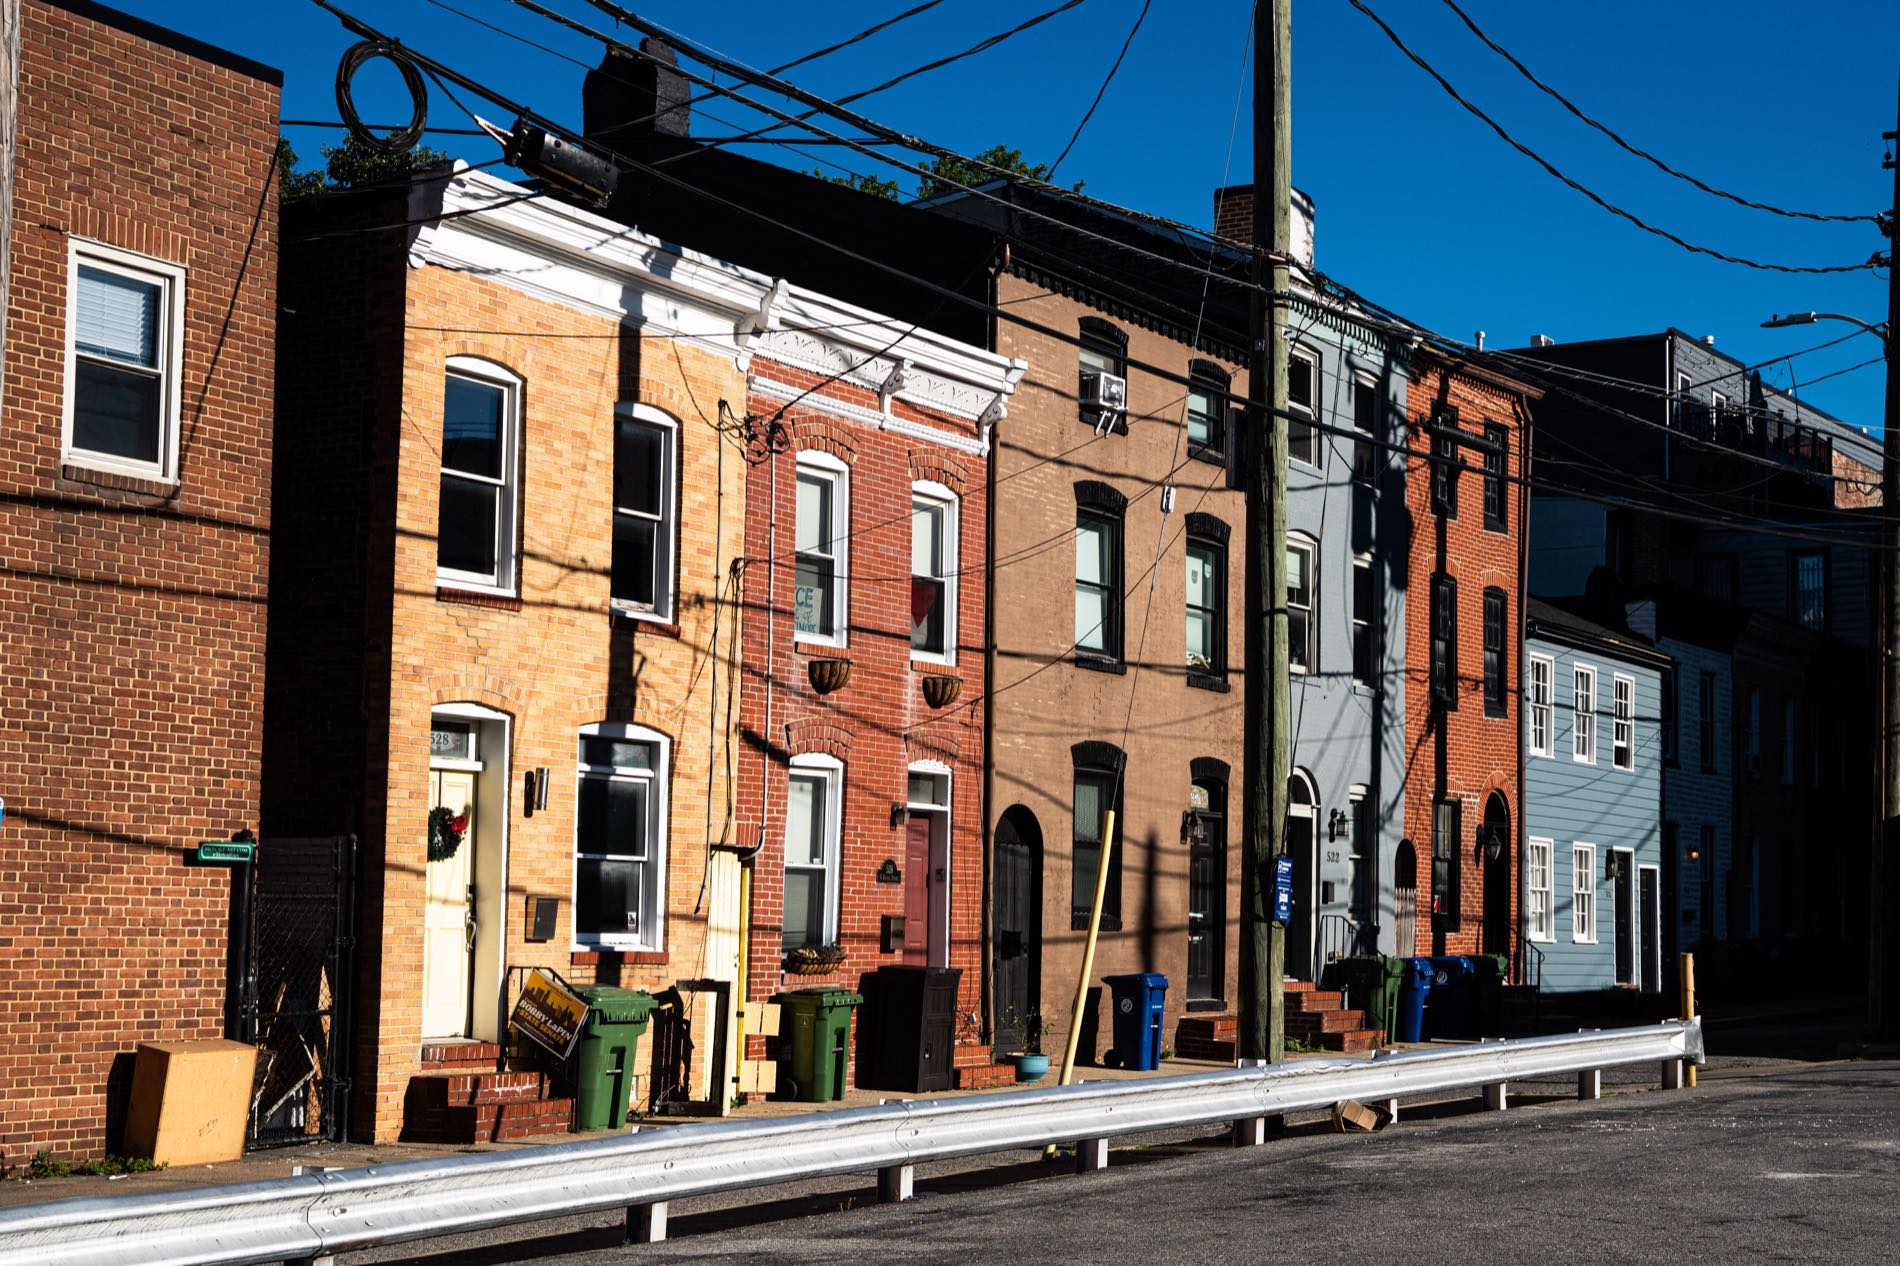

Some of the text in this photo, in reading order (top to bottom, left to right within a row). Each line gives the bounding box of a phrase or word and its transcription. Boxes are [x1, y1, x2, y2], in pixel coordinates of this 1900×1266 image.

[431, 733, 449, 745] 528
[1327, 850, 1340, 864] 522
[519, 1000, 549, 1022] BOBBY
[546, 1019, 573, 1040] LaPIN
[519, 1010, 541, 1026] STATE
[540, 1024, 566, 1045] SENATE
